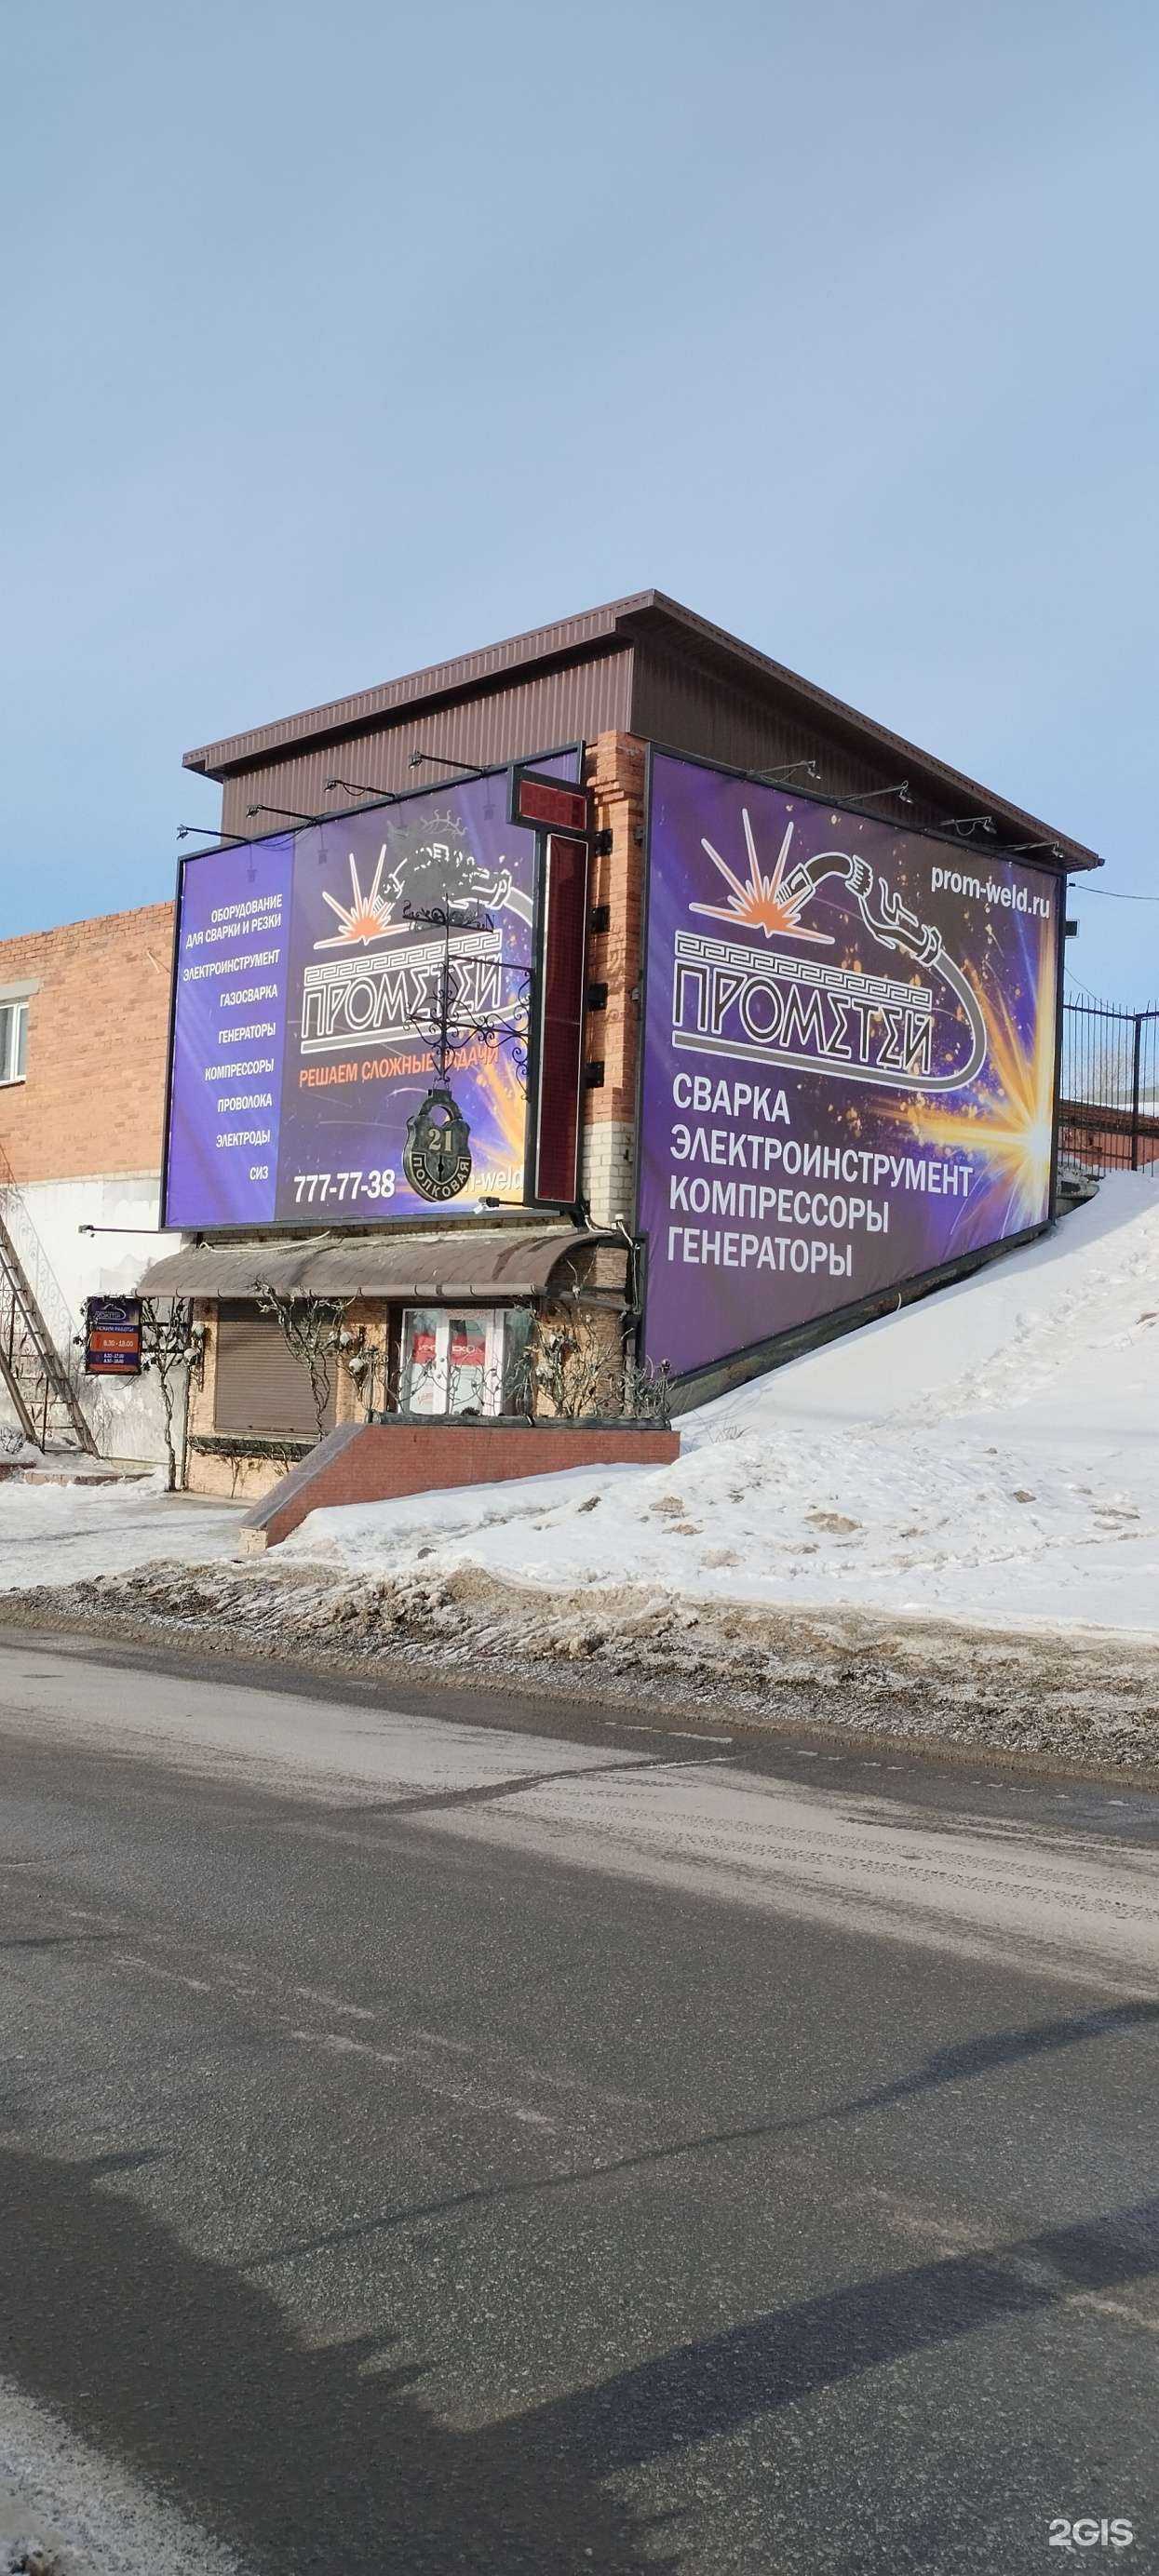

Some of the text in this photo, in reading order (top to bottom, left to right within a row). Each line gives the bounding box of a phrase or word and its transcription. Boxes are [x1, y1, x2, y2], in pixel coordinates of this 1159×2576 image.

[211, 894, 283, 923] ОБОРУДОВАНИЕ
[931, 866, 1050, 919] prom-weld.ru
[185, 913, 281, 949] ДЛЯ СВАРКИ И РЕЗКИ
[182, 949, 281, 982] ЭЛЕКТРОИНСТРУМЕНТ
[220, 984, 278, 1007] ГАЗОСВАРКА
[218, 1022, 276, 1044] ГЕНЕРАТОРЫ
[205, 1058, 275, 1081] КОМПРЕССОРЫ
[299, 1063, 358, 1088] РЕШАЕМ
[362, 1052, 435, 1081] СЛОЖНЫЕ
[217, 1093, 273, 1113] ПРОВОЛОКА
[672, 1072, 790, 1125] СВАРКА
[216, 1130, 271, 1147] ЭЛЕКТРОДЫ
[428, 1128, 453, 1152] 21
[249, 1165, 269, 1181] СИЗ
[669, 1123, 974, 1197] ЭЛЕКТРОИНСТРУМЕНТ
[294, 1169, 396, 1203] 777-77-38
[412, 1157, 470, 1198] ПОЛКОВАЯ
[669, 1174, 889, 1233] КОМПРЕССОРЫ
[667, 1226, 853, 1277] ГЕНЕРАТОРЫ
